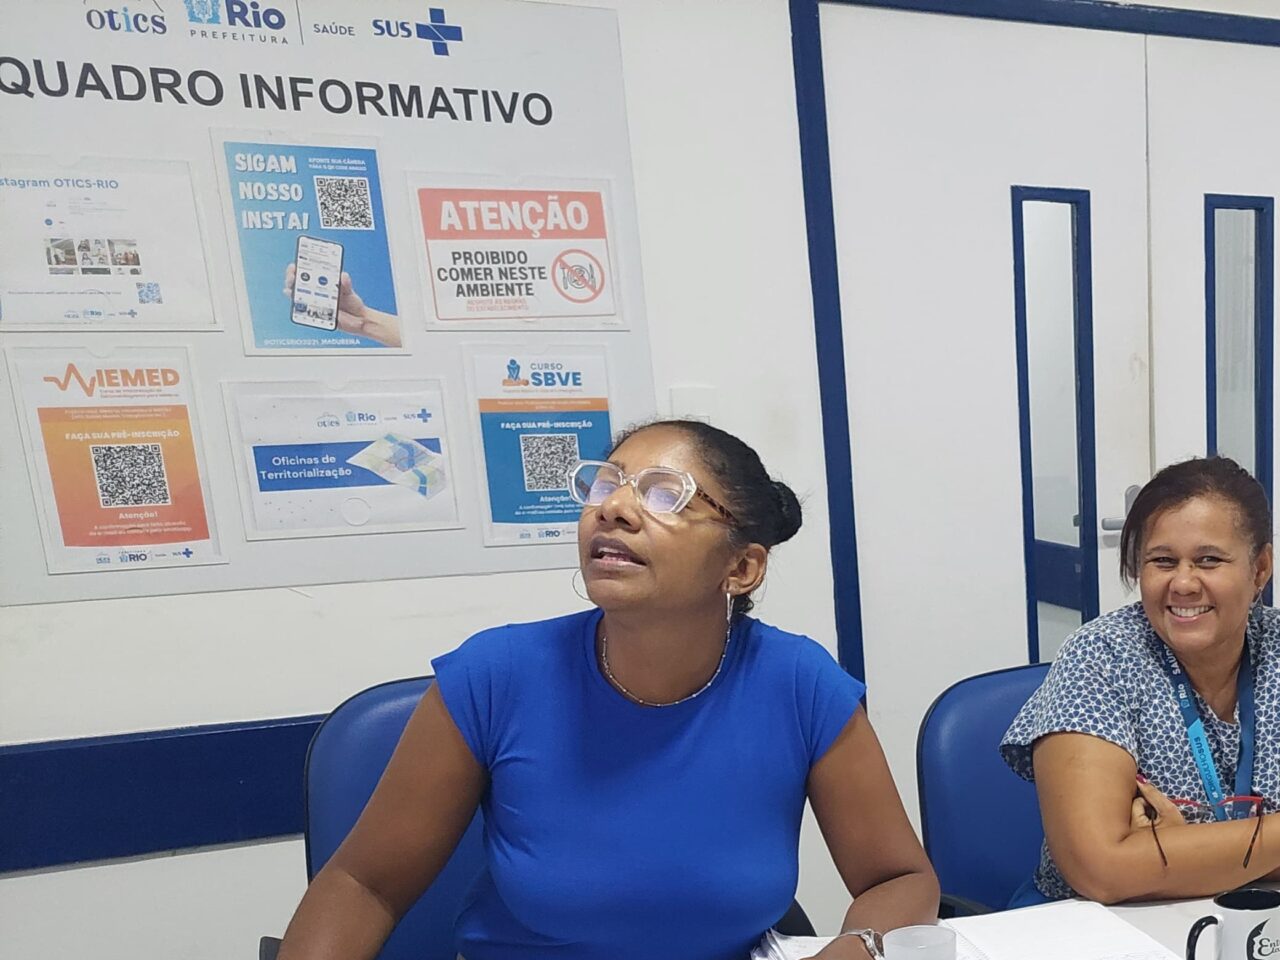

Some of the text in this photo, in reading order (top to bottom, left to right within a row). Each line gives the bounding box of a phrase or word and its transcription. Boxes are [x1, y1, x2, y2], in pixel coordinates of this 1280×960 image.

[86, 7, 167, 35] otics
[225, 0, 286, 30] Rio
[313, 22, 356, 36] SAÚDE
[372, 19, 412, 38] SUS
[190, 29, 289, 45] PREFEITURA
[0, 56, 553, 126] QUADRO INFORMATIVO
[235, 152, 297, 174] SIGAM
[54, 178, 119, 189] OTICS-RIO
[238, 181, 303, 201] NOSSO
[440, 194, 589, 238] ATENÇÃO
[451, 250, 528, 265] PROIBIDO
[437, 266, 548, 281] COMER NESTE
[456, 282, 535, 297] AMBIENTE
[530, 362, 563, 370] CURSO
[96, 368, 180, 388] IEMED
[530, 372, 582, 387] SBVE
[358, 412, 376, 422] Rio
[501, 422, 521, 431] FAÇA
[65, 432, 91, 441] FAÇA
[272, 454, 336, 466] Oficinas de
[260, 467, 352, 480] Territorialização
[128, 553, 147, 562] RIO
